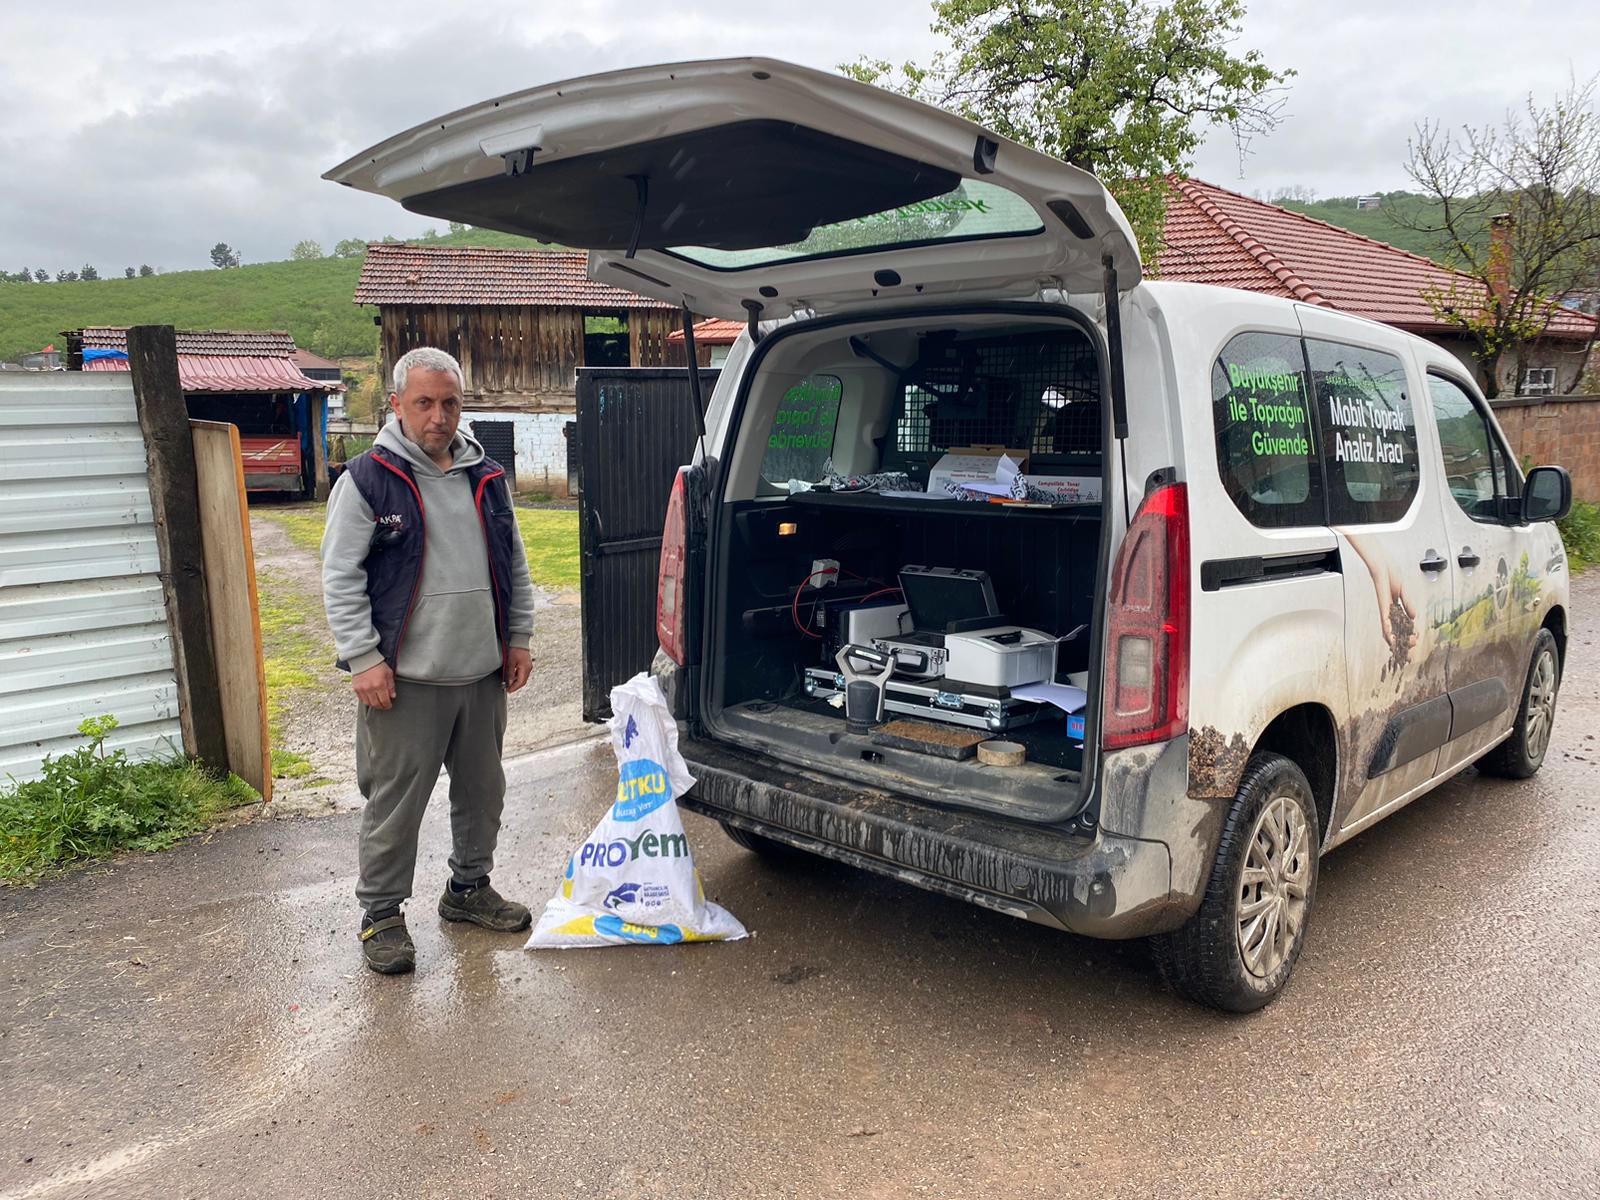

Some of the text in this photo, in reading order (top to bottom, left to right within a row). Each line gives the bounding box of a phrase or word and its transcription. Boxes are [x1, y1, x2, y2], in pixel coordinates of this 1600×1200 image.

[1229, 396, 1305, 428] ile Toprağın
[1329, 396, 1406, 434] Mobil Toprak
[1251, 431, 1309, 456] Güvende
[1335, 432, 1404, 464] Analiz Aracı
